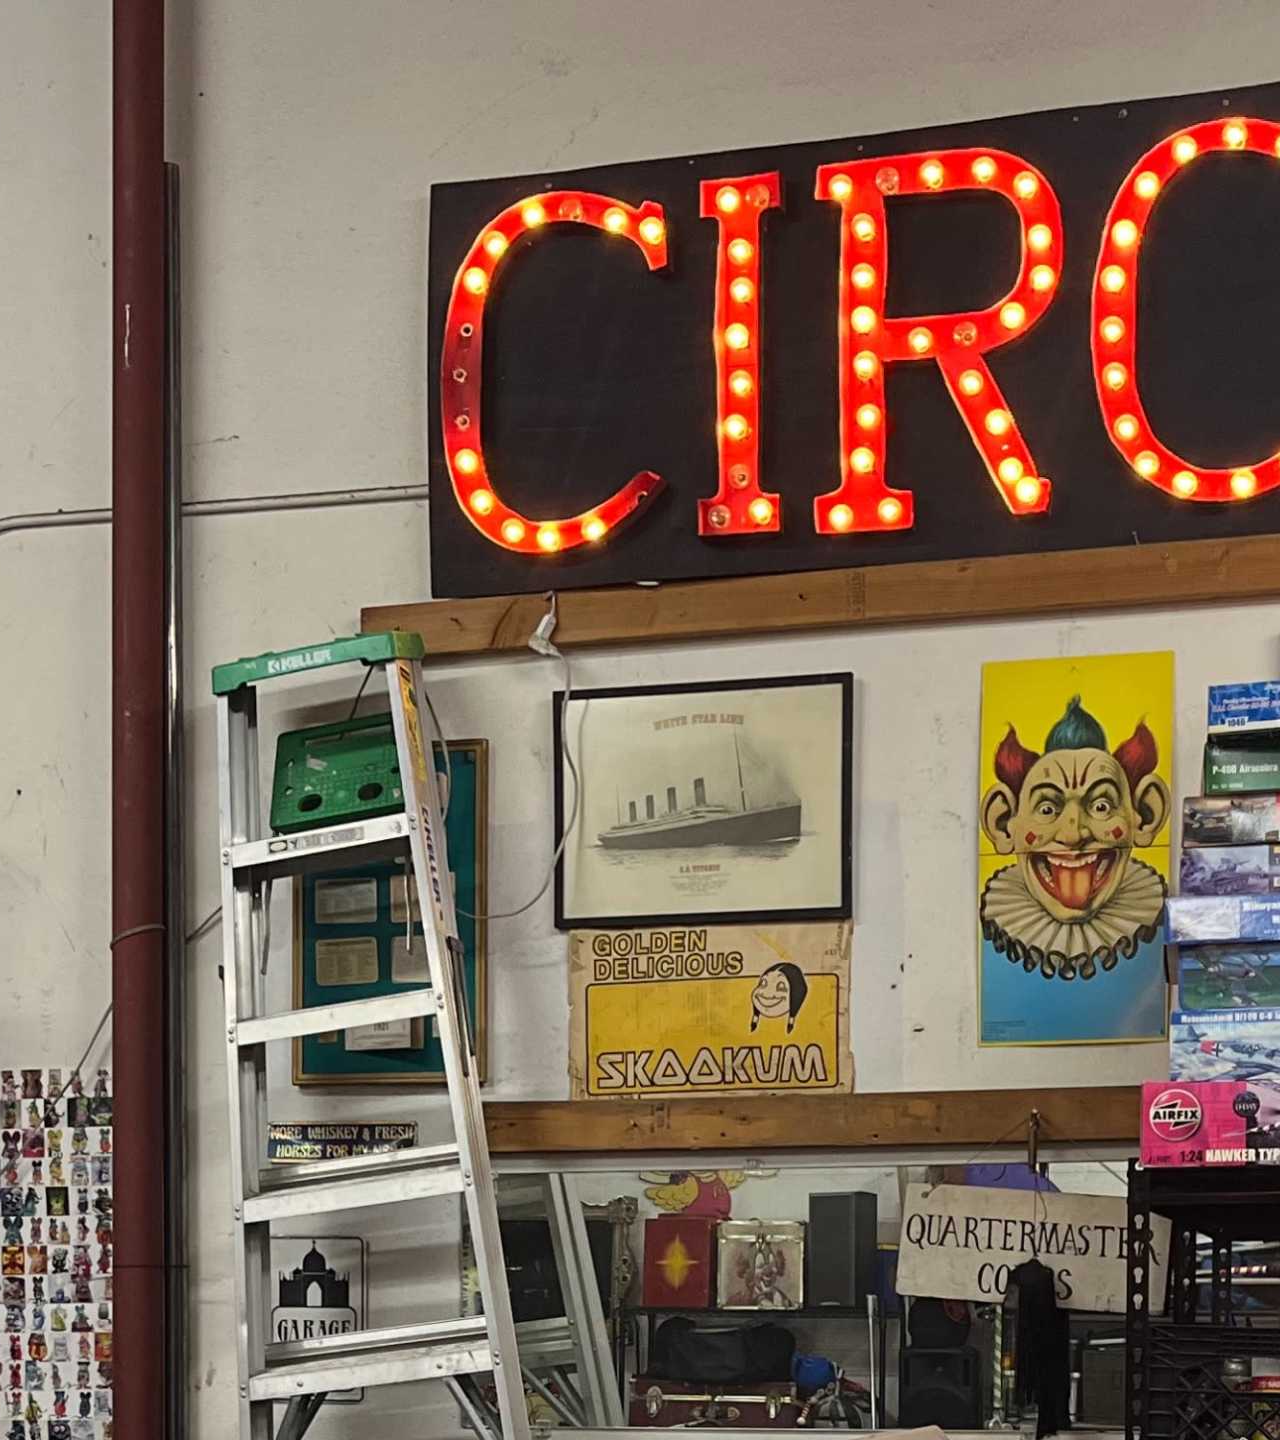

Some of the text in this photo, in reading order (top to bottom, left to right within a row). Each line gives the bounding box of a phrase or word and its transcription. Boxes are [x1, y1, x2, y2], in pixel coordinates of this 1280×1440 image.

[280, 648, 333, 671] KELLER
[653, 713, 745, 731] WHITE STAR LINE
[592, 929, 707, 957] GOLDEN
[592, 951, 744, 981] DELICIOUS
[1151, 1109, 1200, 1122] AIRFIX
[271, 1126, 303, 1140] MORE
[307, 1126, 359, 1140] WHISKEY
[375, 1125, 415, 1140] FRESH
[276, 1143, 323, 1159] HORSES
[326, 1144, 349, 1158] FOR
[1179, 1150, 1203, 1163] 1:24
[1205, 1148, 1256, 1163] HAWKER
[977, 1262, 1073, 1301] COS
[276, 1318, 352, 1342] GARAGE
